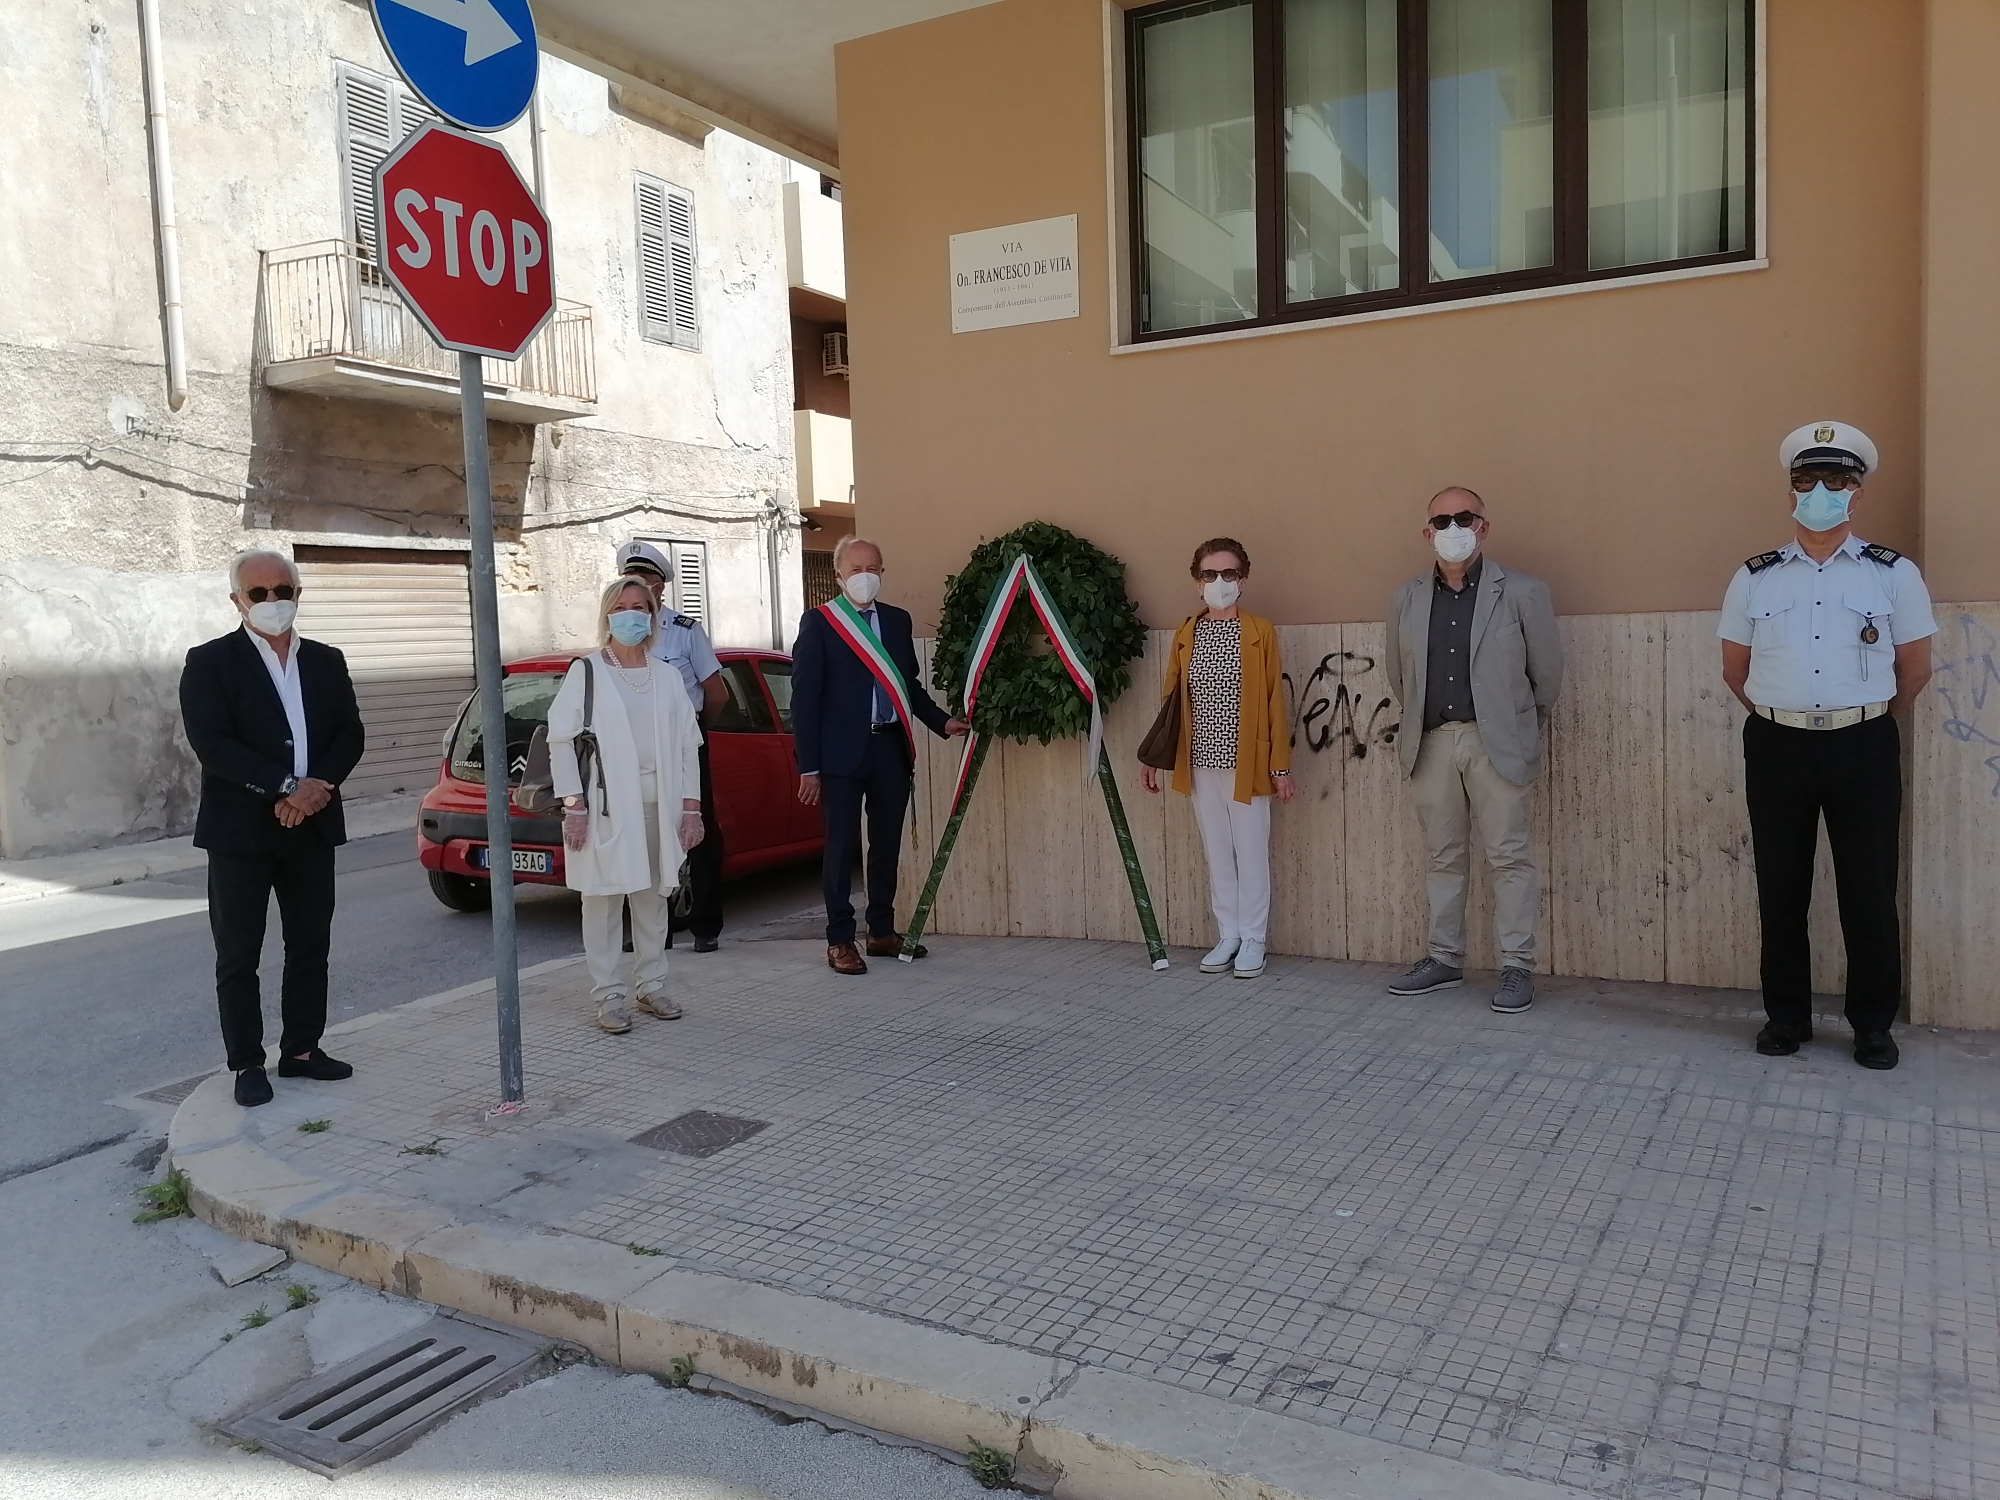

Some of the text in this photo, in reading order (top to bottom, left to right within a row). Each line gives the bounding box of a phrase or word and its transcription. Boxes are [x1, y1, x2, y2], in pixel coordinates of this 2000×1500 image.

[394, 188, 542, 295] STOP
[1001, 241, 1024, 254] VIA
[956, 255, 1072, 288] On. FRANCESCO DE VITA
[957, 303, 993, 315] Componente
[1039, 292, 1073, 303] Costituente
